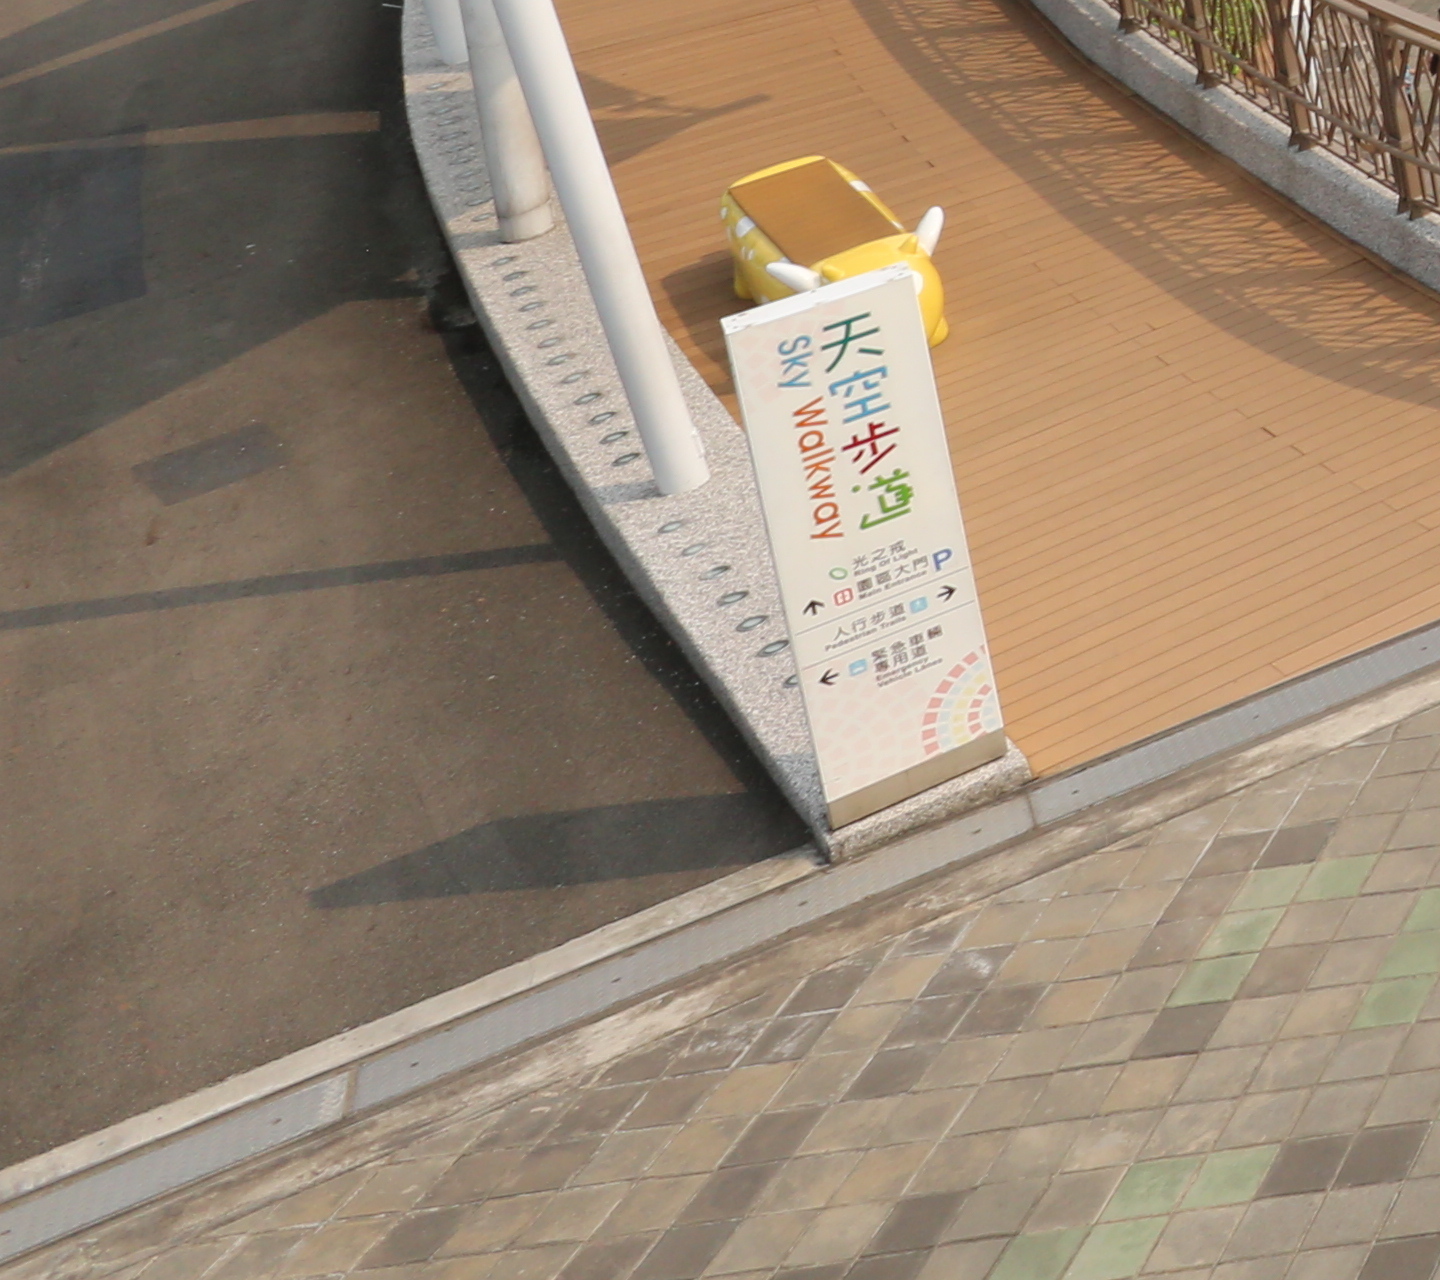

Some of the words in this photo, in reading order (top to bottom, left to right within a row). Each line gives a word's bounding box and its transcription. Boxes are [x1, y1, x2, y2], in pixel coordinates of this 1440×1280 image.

[777, 335, 814, 388] Sky
[821, 312, 914, 530] 天空步道
[792, 395, 845, 540] Walkway
[852, 540, 906, 570] 光之戒
[854, 564, 877, 577] Ring
[893, 548, 918, 562] Light
[932, 547, 953, 572] P
[856, 555, 929, 592] 園區大門
[858, 587, 882, 600] Main
[884, 570, 928, 590] Entrance
[833, 603, 905, 641] 人行步道
[824, 627, 878, 652] Pedestrian
[875, 656, 929, 682] Emergency
